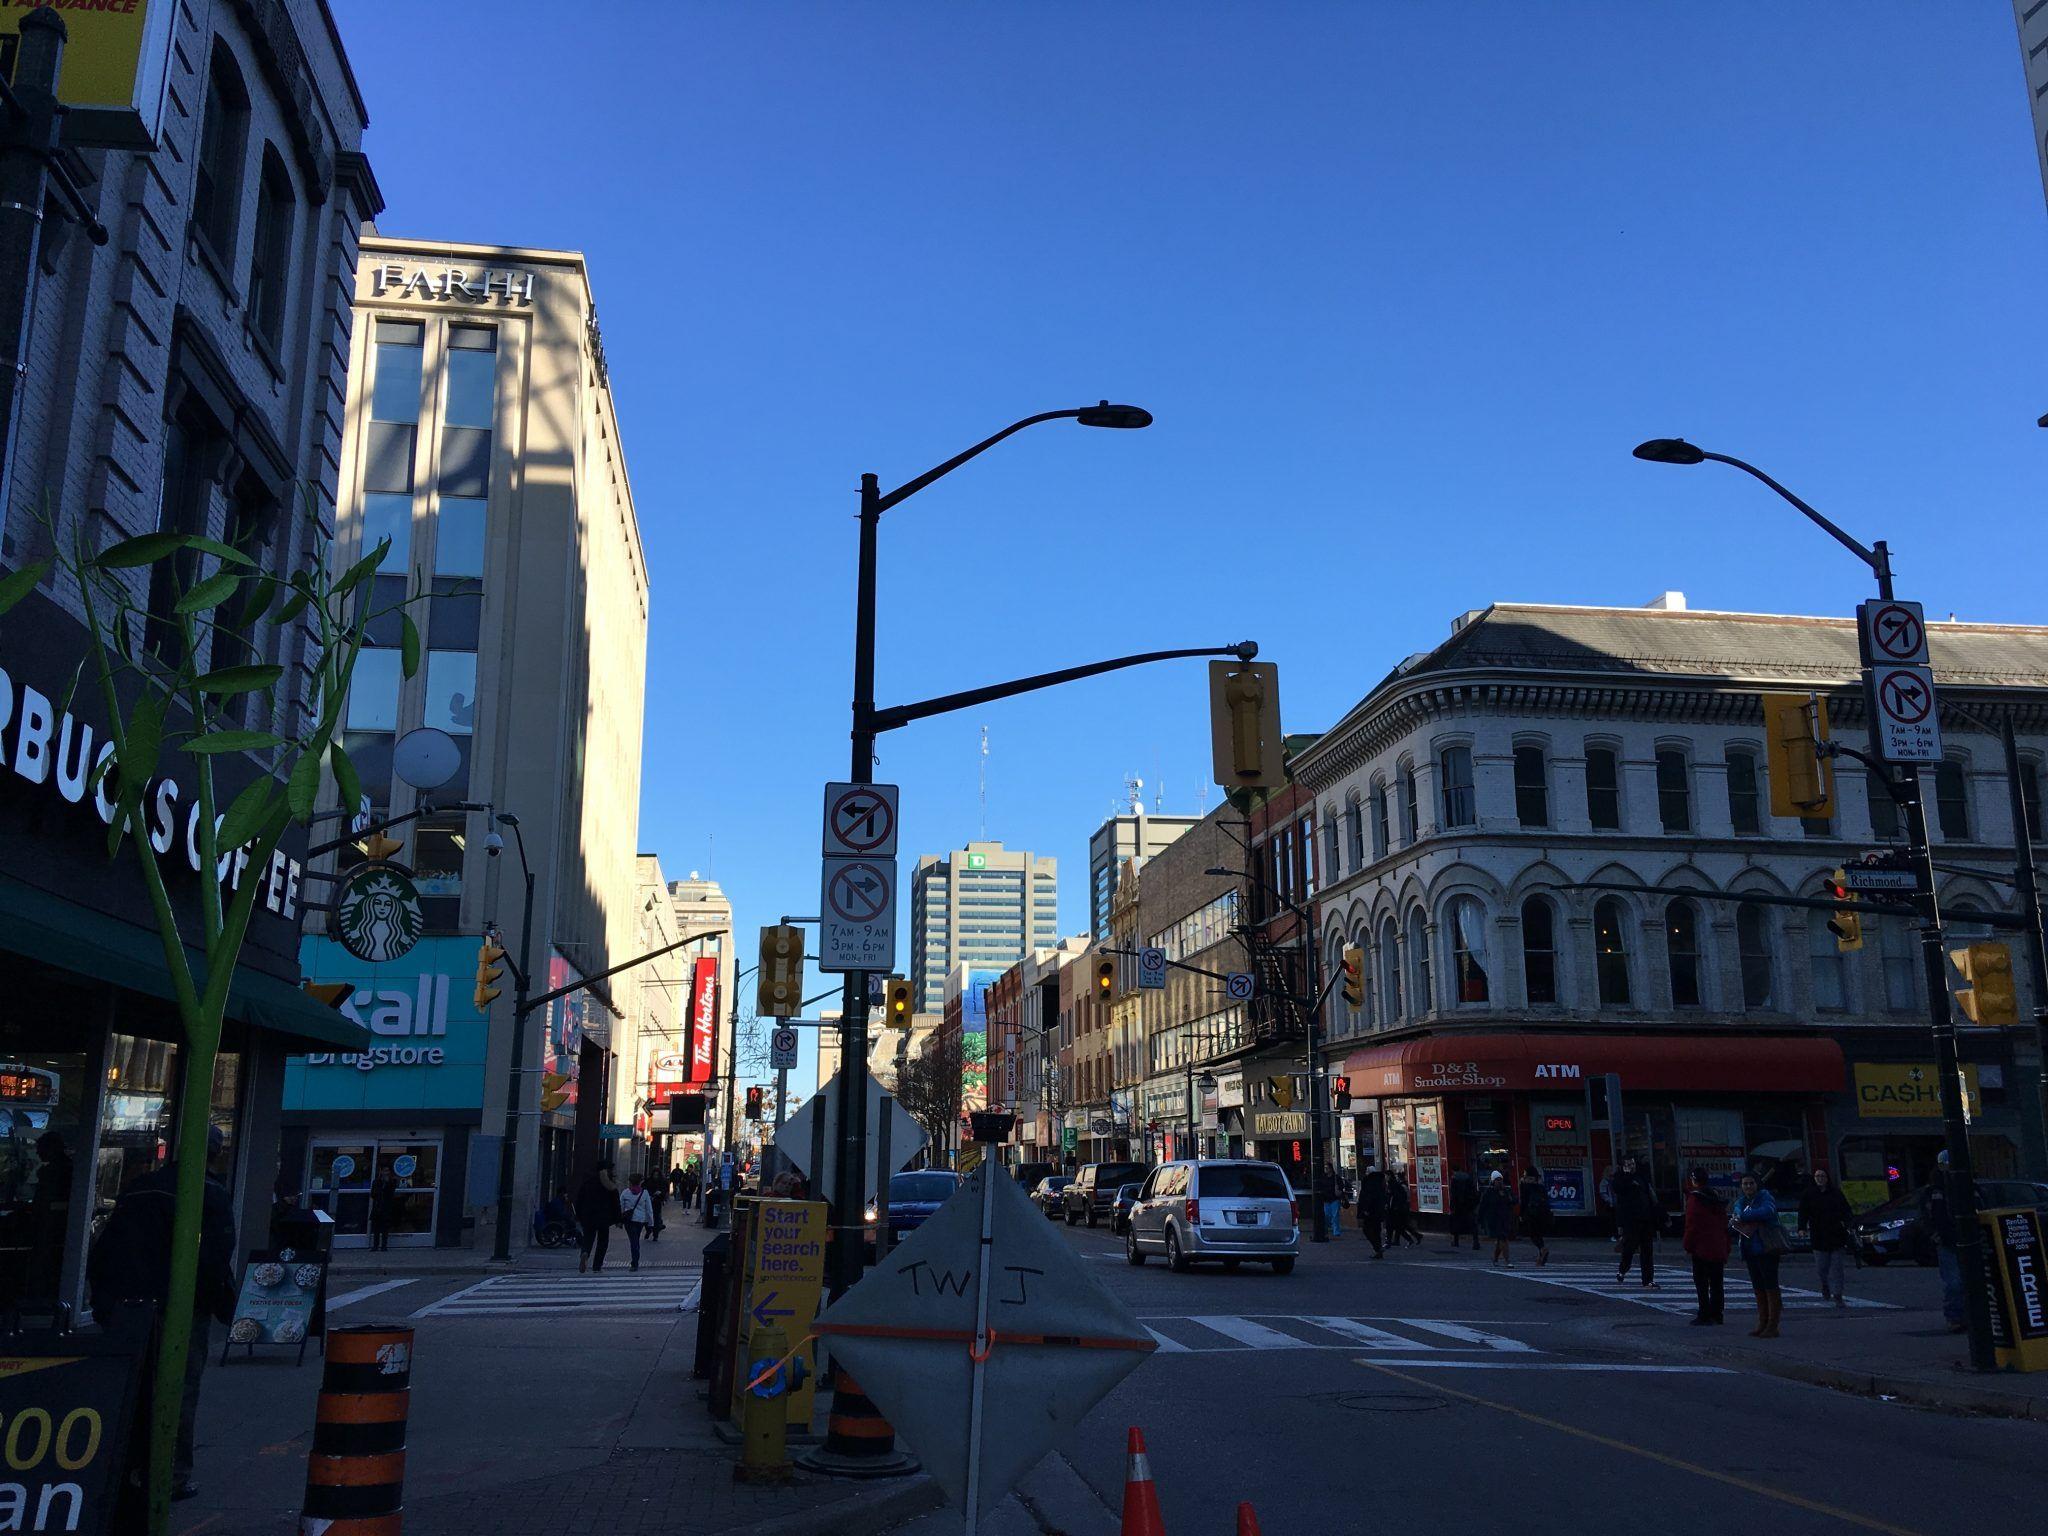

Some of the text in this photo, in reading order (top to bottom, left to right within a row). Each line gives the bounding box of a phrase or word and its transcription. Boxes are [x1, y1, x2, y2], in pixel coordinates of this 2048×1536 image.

[379, 264, 534, 300] FARHI
[0, 664, 301, 921] BUCS COFEE
[970, 855, 985, 867] TD
[1850, 874, 1903, 888] Richmond
[694, 975, 715, 1065] Tim Hortons
[308, 1043, 444, 1071] Drugstore
[1383, 1072, 1400, 1086] ATM
[1534, 1064, 1580, 1078] ATM
[1414, 1072, 1506, 1088] Smoke Shop
[1281, 1112, 1306, 1133] PAWN
[1546, 1119, 1574, 1129] OPEN
[765, 1207, 809, 1224] Start
[764, 1227, 802, 1241] your
[762, 1241, 820, 1257] search
[761, 1255, 804, 1271] here.
[2017, 1254, 2045, 1328] FREE
[0, 1407, 102, 1471] 00
